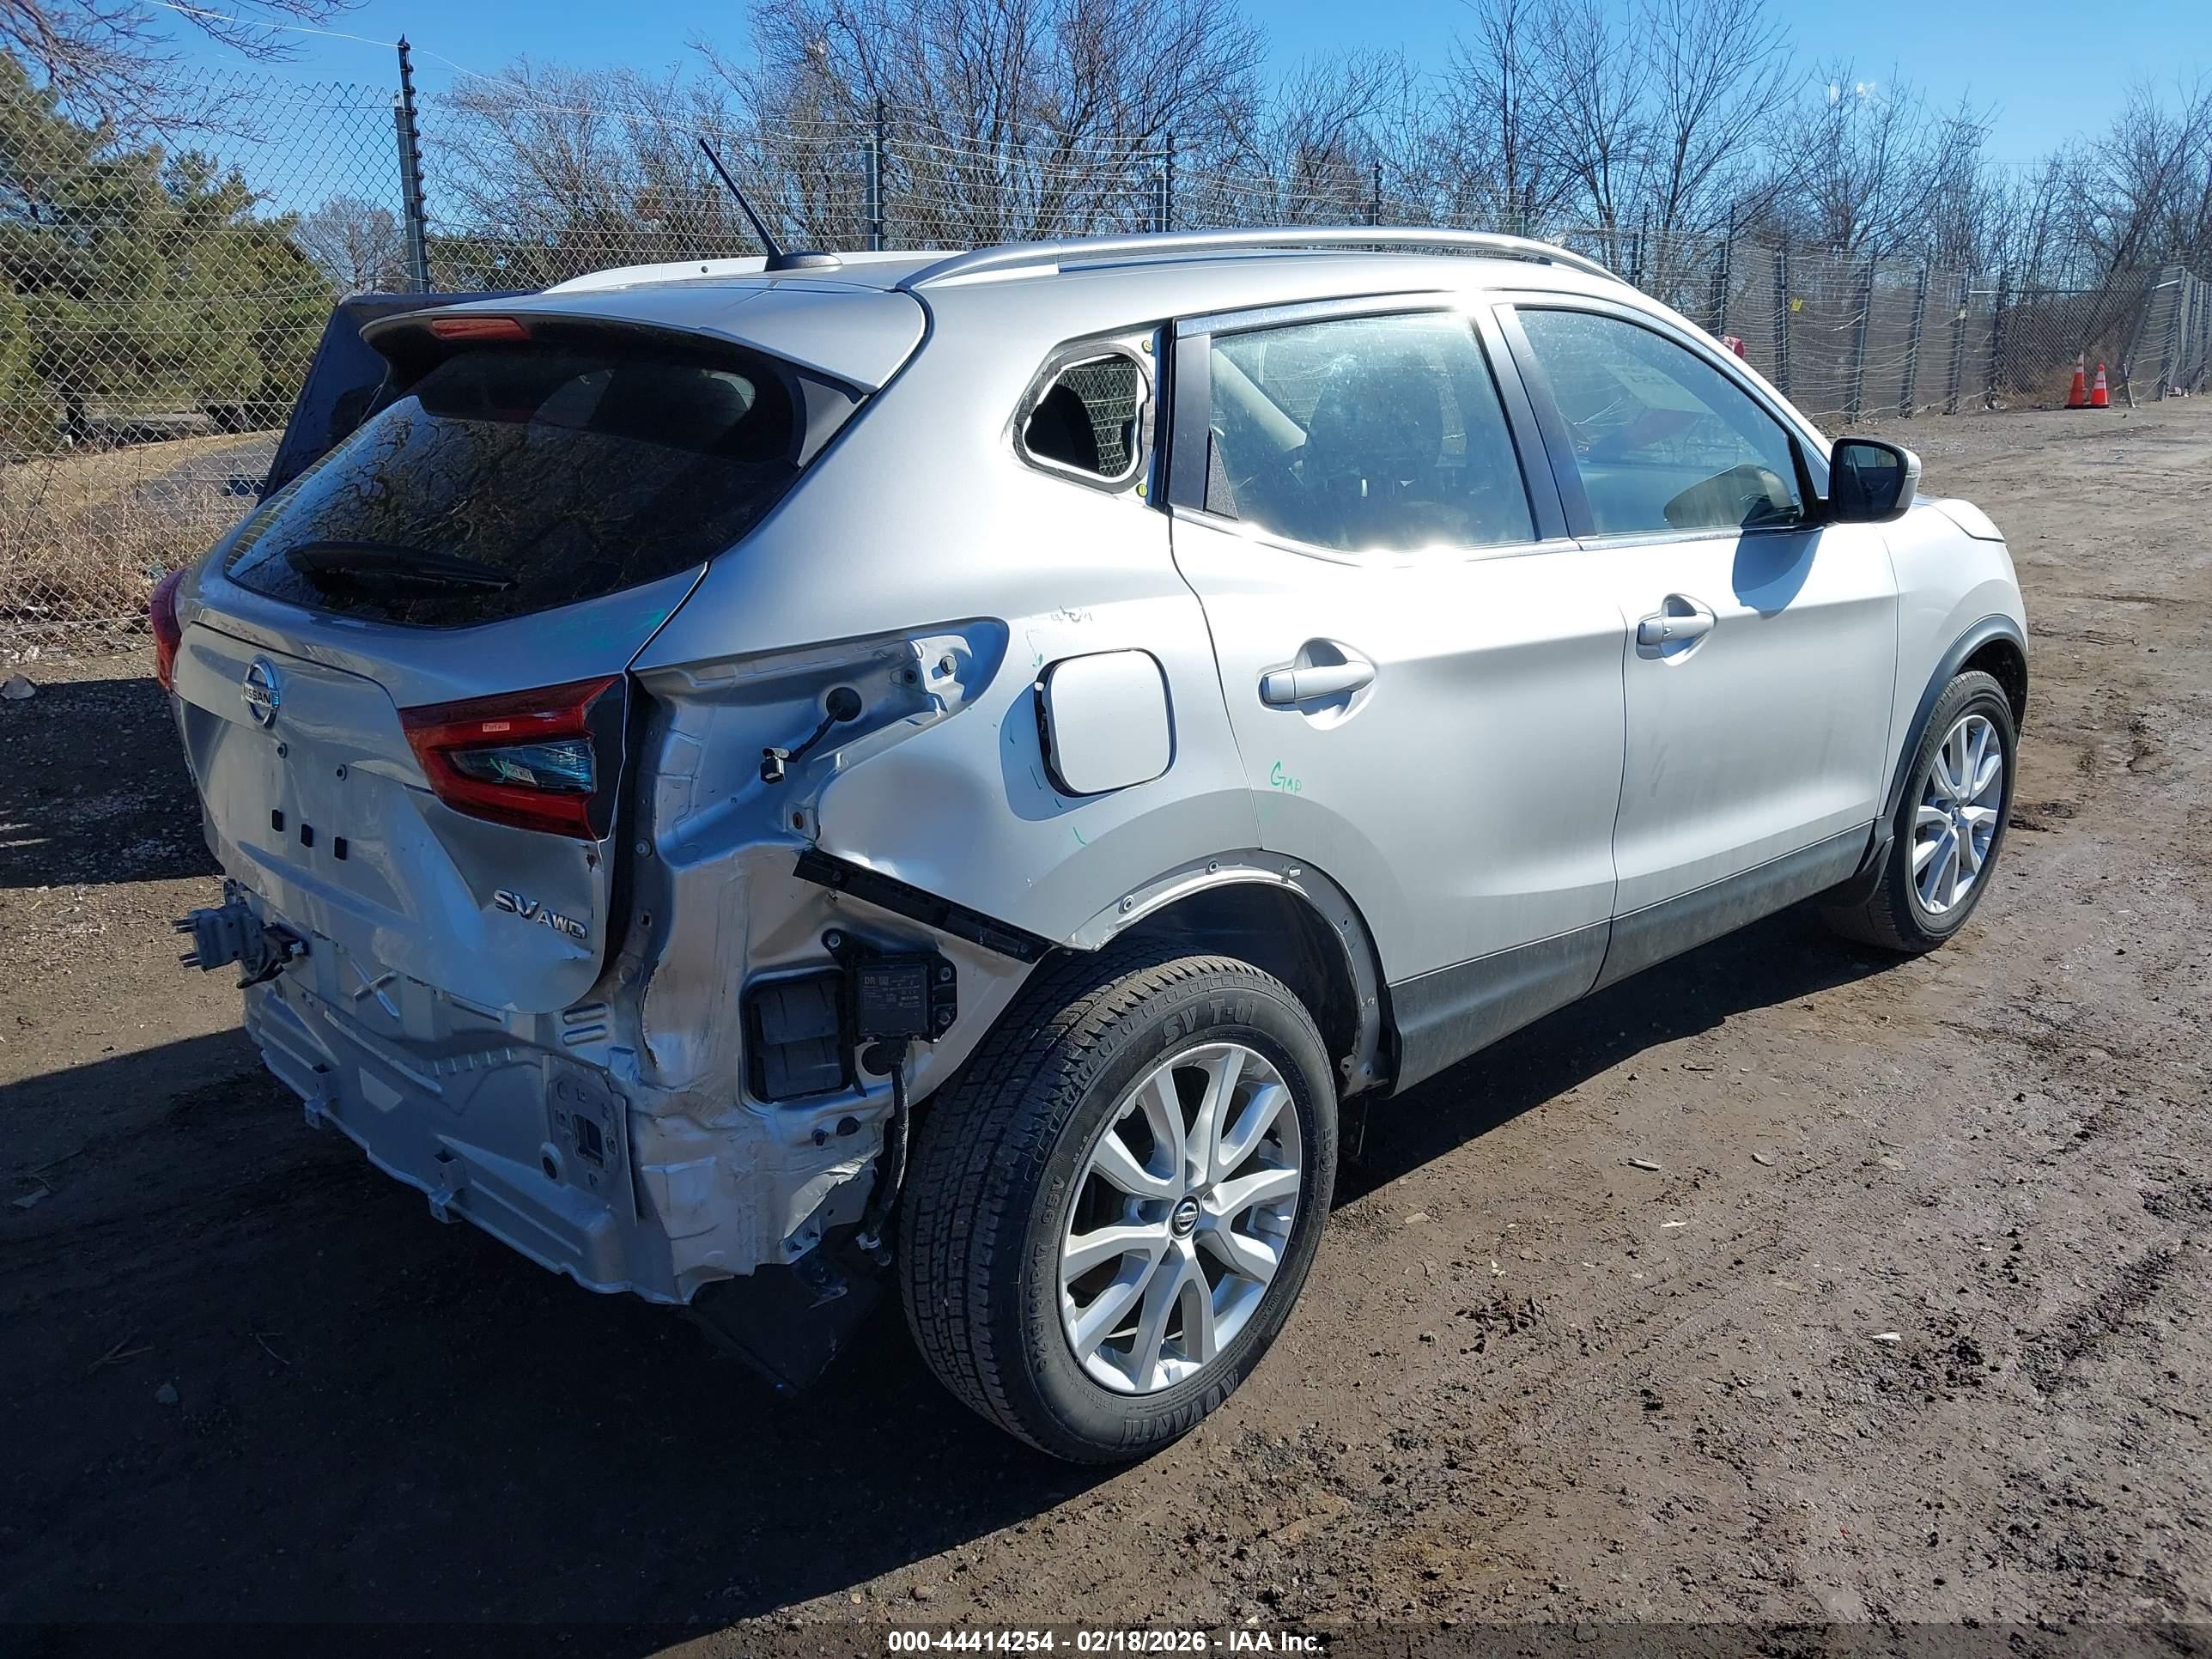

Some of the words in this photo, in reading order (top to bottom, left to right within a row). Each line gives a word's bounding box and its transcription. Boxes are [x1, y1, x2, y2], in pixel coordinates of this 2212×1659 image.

[243, 684, 272, 705] NISSAN
[494, 889, 540, 921] SV
[536, 909, 588, 940] AWD
[1162, 1006, 1198, 1048] SV
